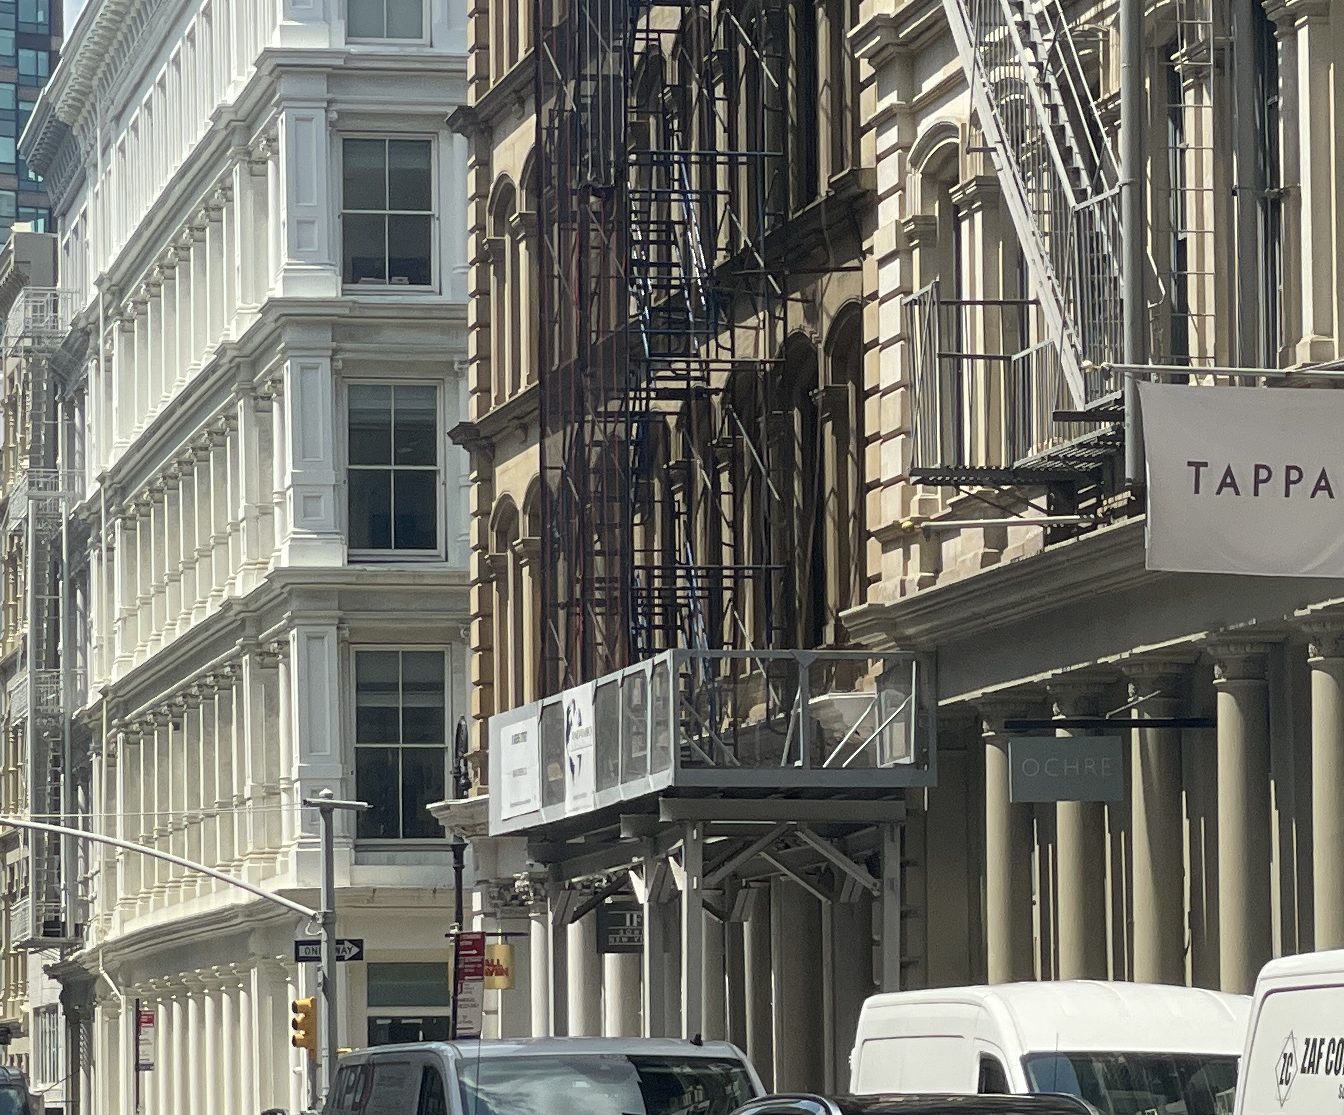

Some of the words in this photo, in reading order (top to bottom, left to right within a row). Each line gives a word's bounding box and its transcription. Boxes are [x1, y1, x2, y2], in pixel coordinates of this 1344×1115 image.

[1021, 757, 1113, 778] OCHRE
[1279, 1052, 1294, 1086] ZC
[1300, 1037, 1326, 1075] ZAF
